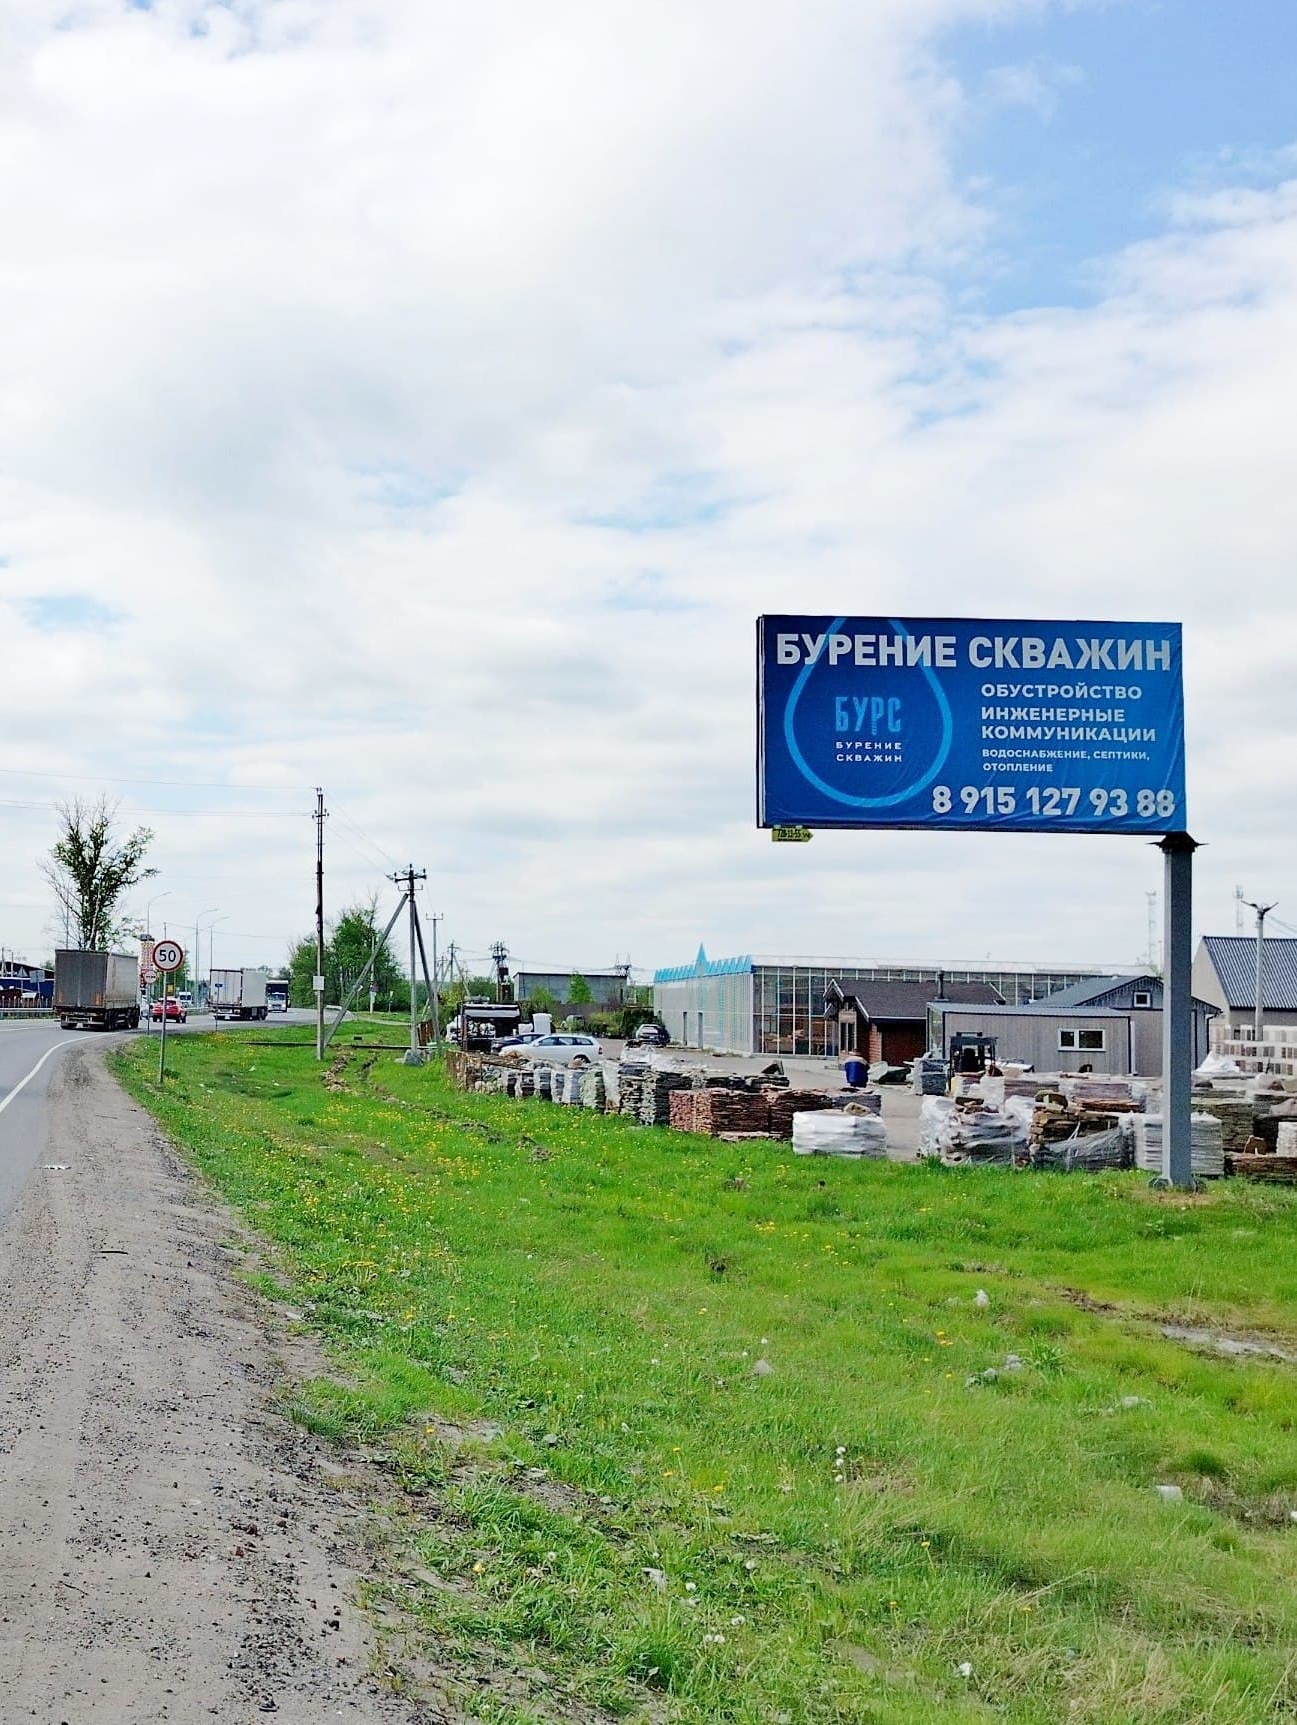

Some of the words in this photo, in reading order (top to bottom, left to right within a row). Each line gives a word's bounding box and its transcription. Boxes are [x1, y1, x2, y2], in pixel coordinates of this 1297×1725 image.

[776, 633, 957, 668] БУРЕНИЕ
[968, 636, 1171, 671] СКВАЖИН
[981, 682, 1142, 699] ОБУСТРОЙСТВО
[835, 696, 901, 735] БУРС
[981, 707, 1125, 722] ИНЖЕНЕРНЫЕ
[981, 726, 1156, 743] КОММУНИКАЦИИ
[836, 741, 902, 750] БУРЕНИЕ
[836, 754, 903, 763] СКВАЖИН
[982, 749, 1090, 760] ВОДОСНАБЖЕНИЕ,
[1093, 751, 1150, 760] СЕПТИКИ,
[983, 763, 1053, 772] ОТОПЛЕНИЕ
[932, 786, 952, 814] 8
[960, 786, 1016, 815] 915
[1026, 787, 1081, 816] 127
[1089, 788, 1128, 817] 93
[1136, 789, 1175, 818] 88
[159, 949, 177, 963] 50
